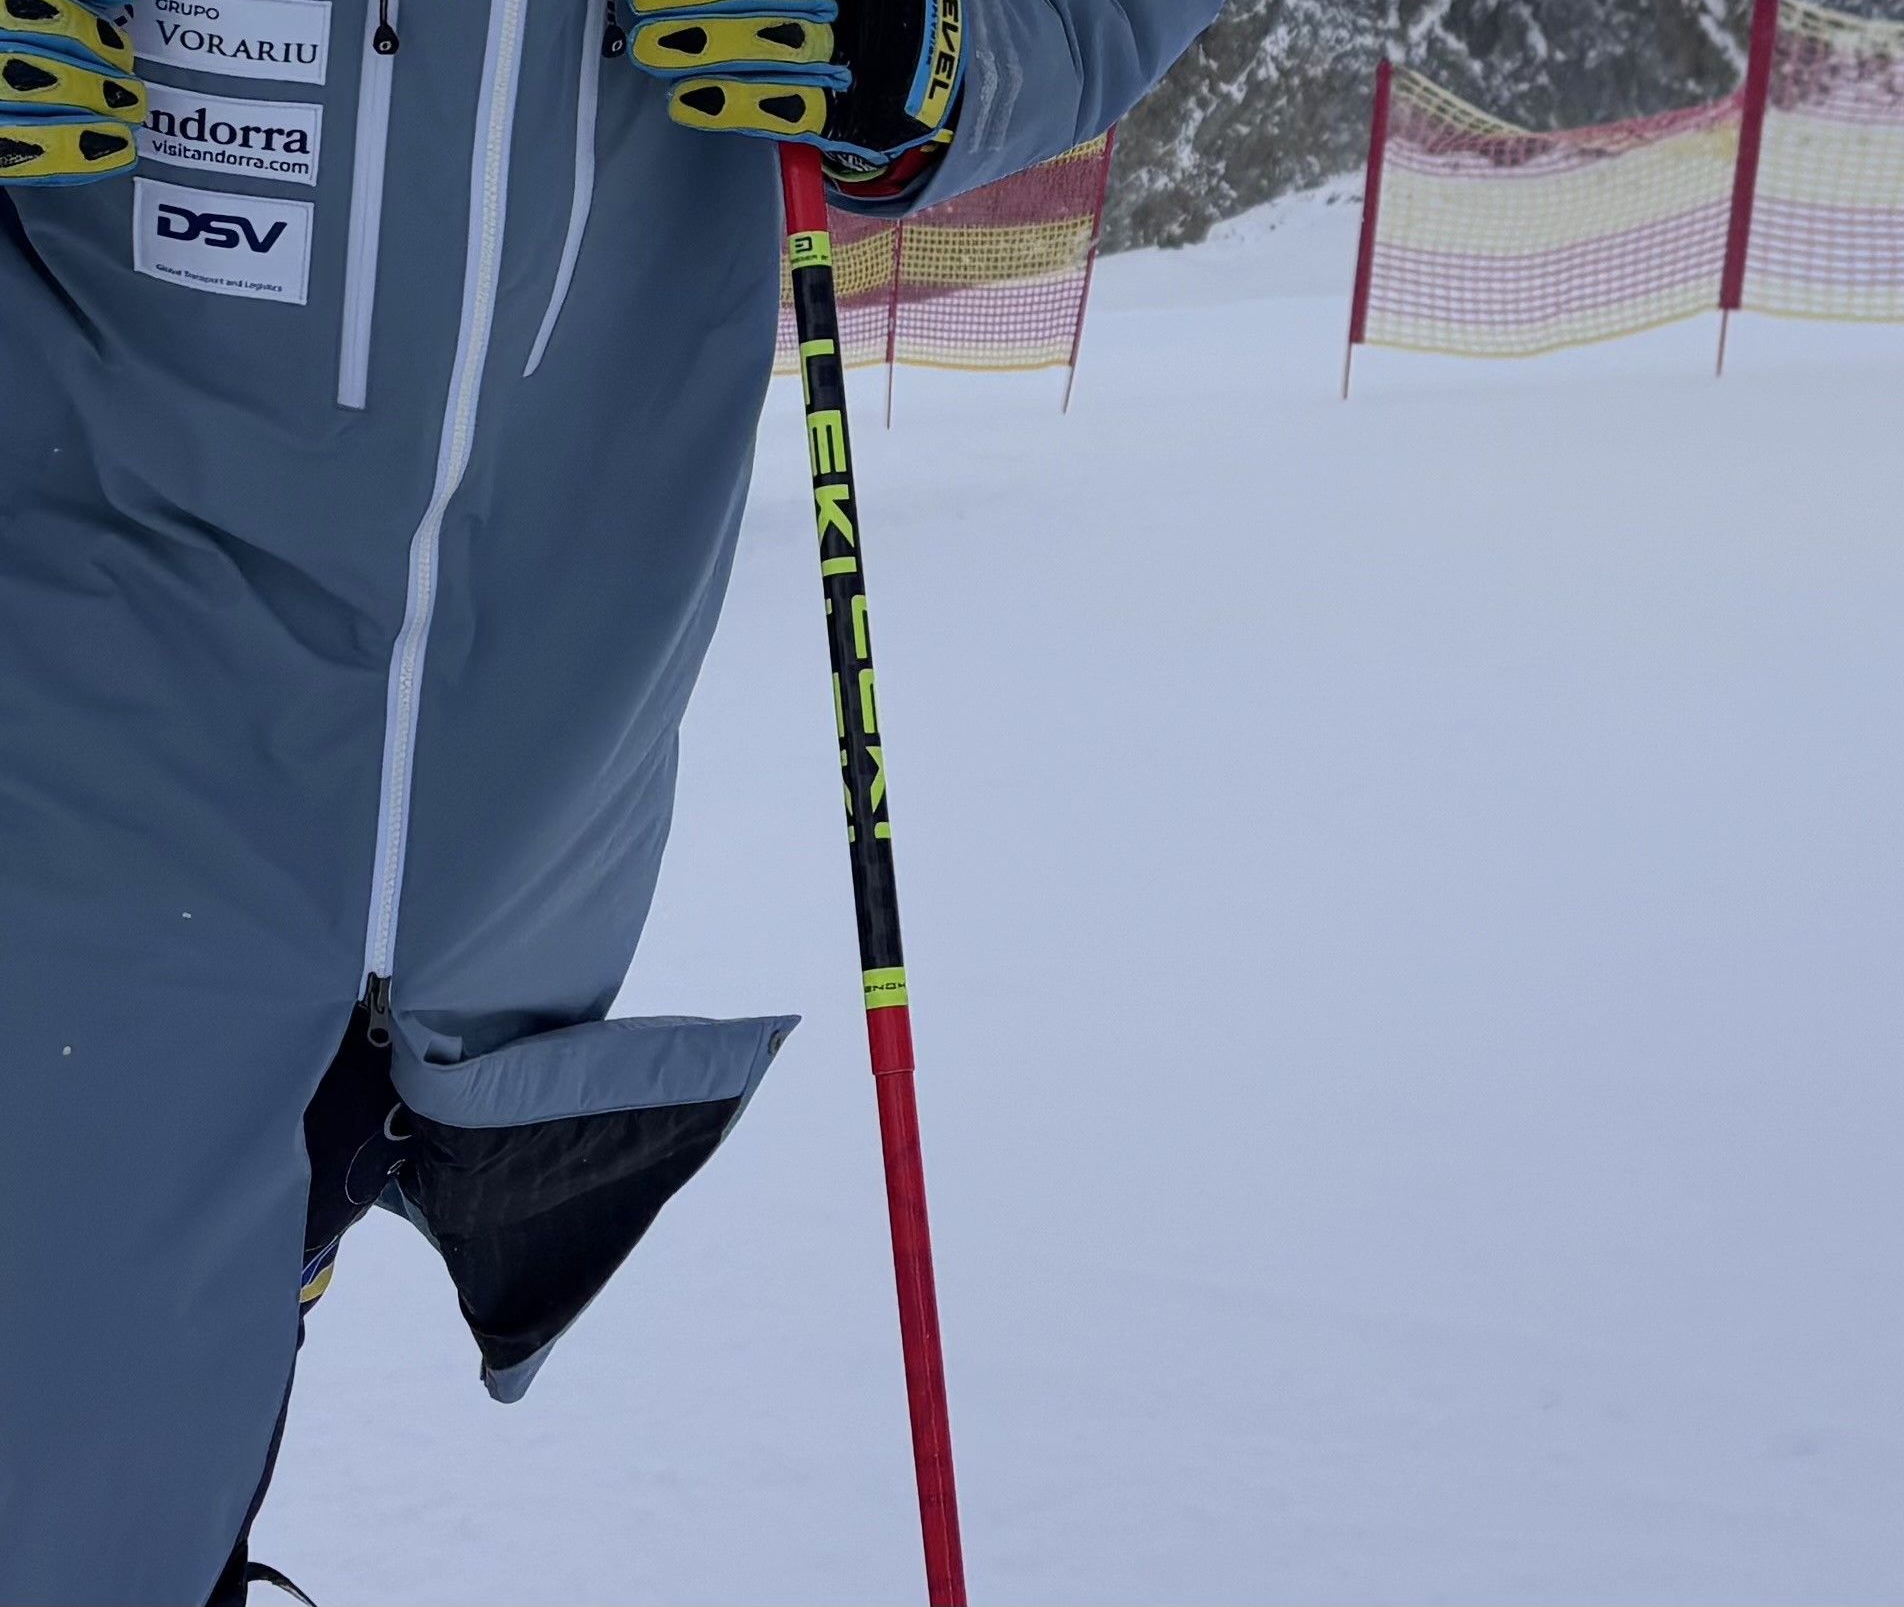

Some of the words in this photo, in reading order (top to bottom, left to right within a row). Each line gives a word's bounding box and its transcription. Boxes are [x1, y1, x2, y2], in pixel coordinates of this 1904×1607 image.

[156, 19, 320, 64] VORARIU
[144, 107, 310, 154] ndorra
[151, 139, 309, 175] visitandorra.com
[156, 203, 288, 254] DSV
[799, 338, 858, 577] LEKI
